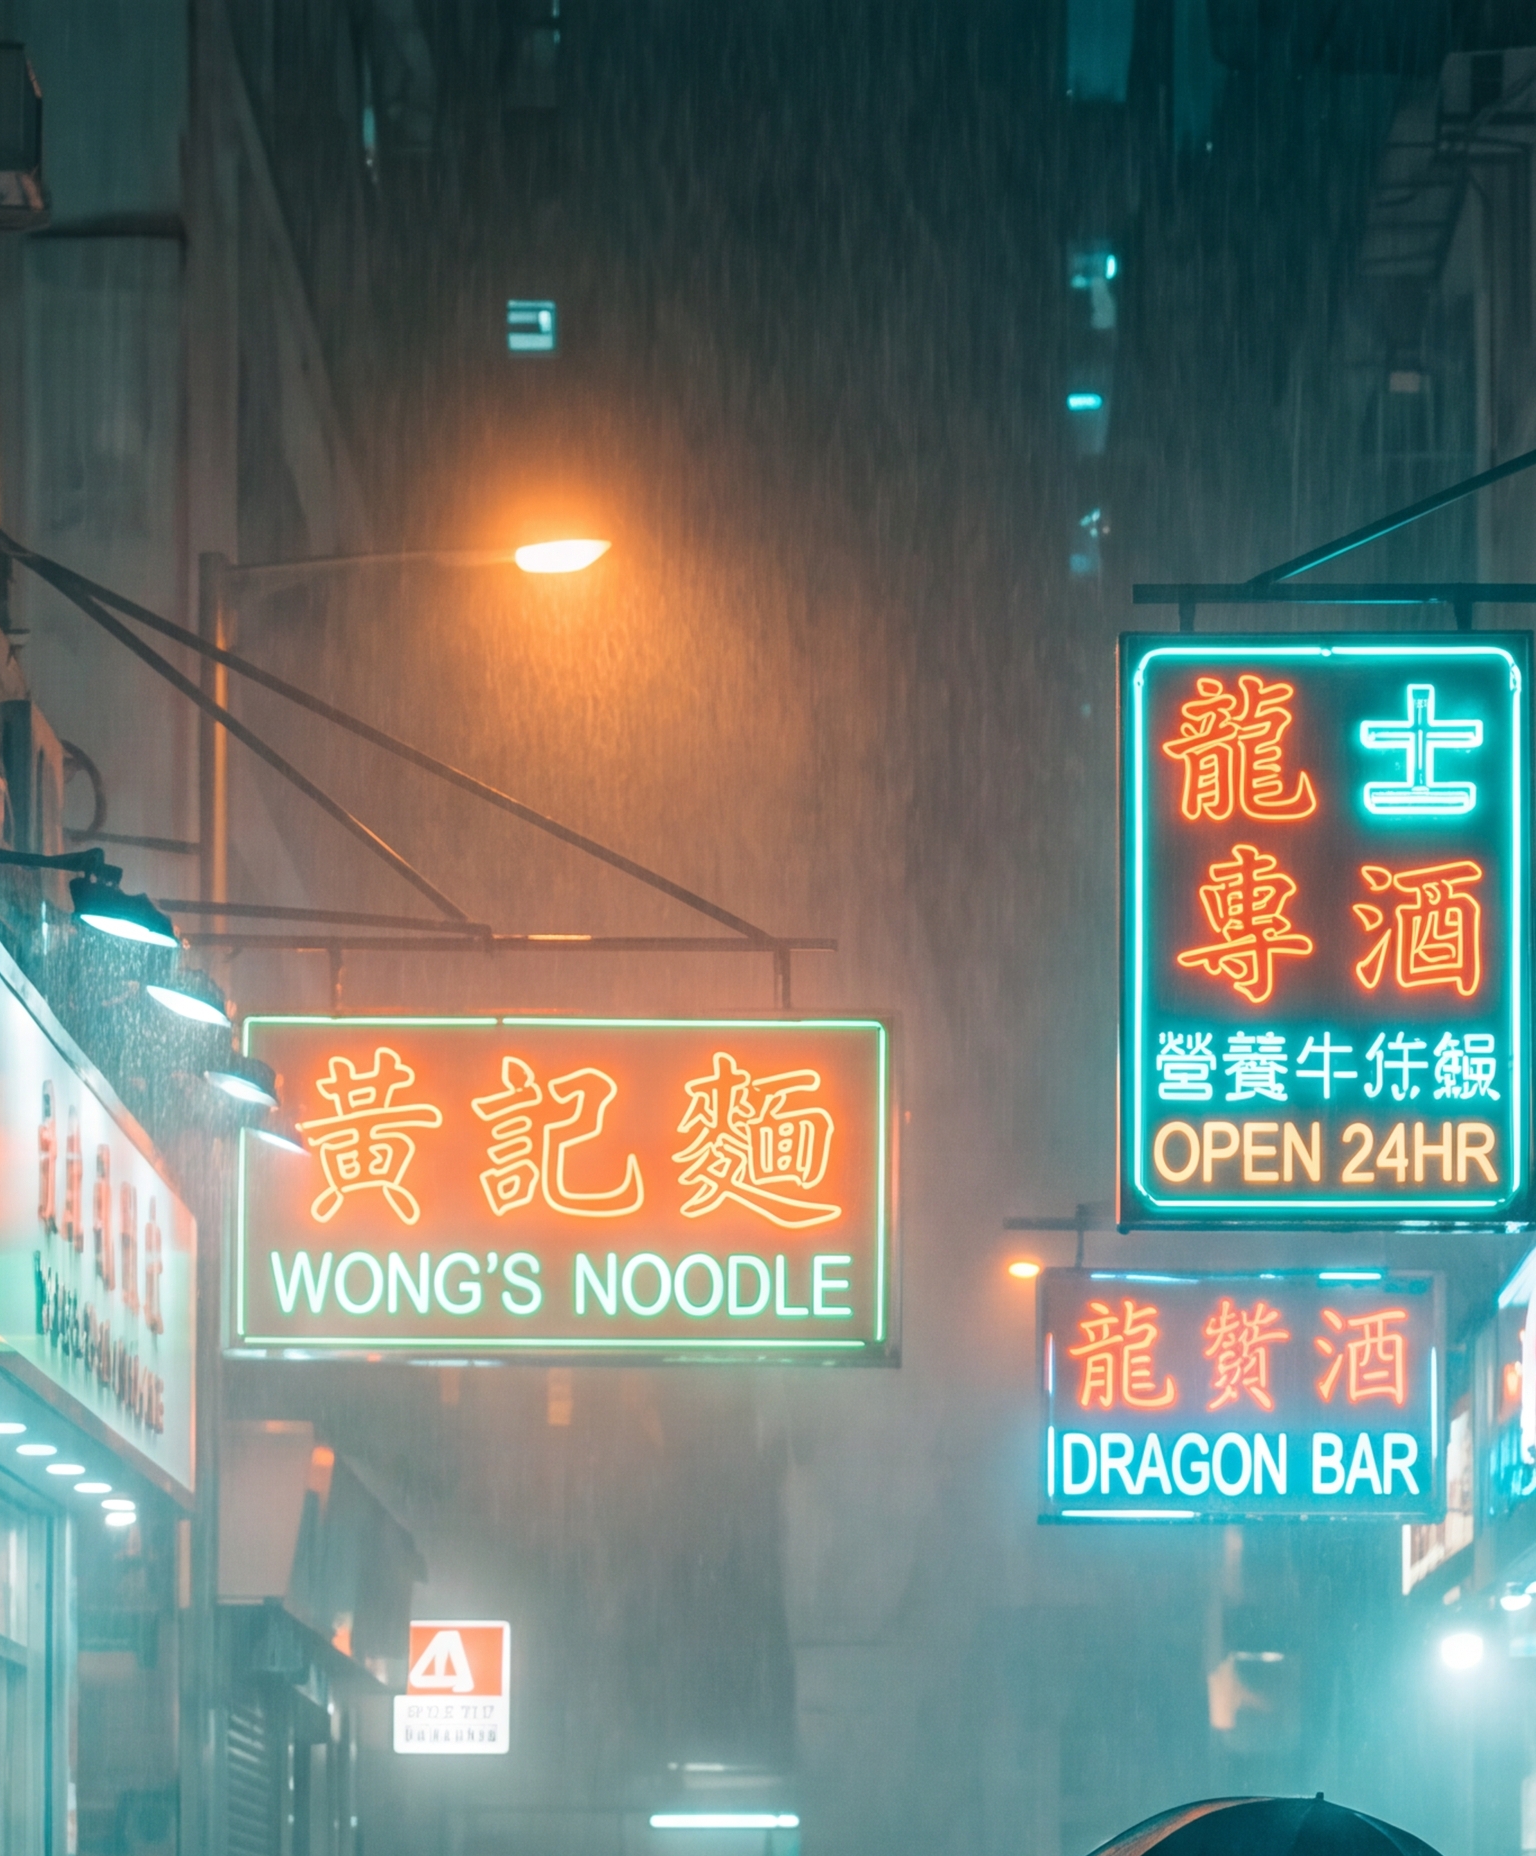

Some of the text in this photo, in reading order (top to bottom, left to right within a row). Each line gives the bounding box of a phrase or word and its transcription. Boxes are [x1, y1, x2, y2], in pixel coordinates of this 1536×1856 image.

[1153, 1120, 1499, 1184] OPEN 24HR
[269, 1250, 854, 1318] WONG'S NOODLE
[1063, 1432, 1421, 1497] DRAGON BAR
